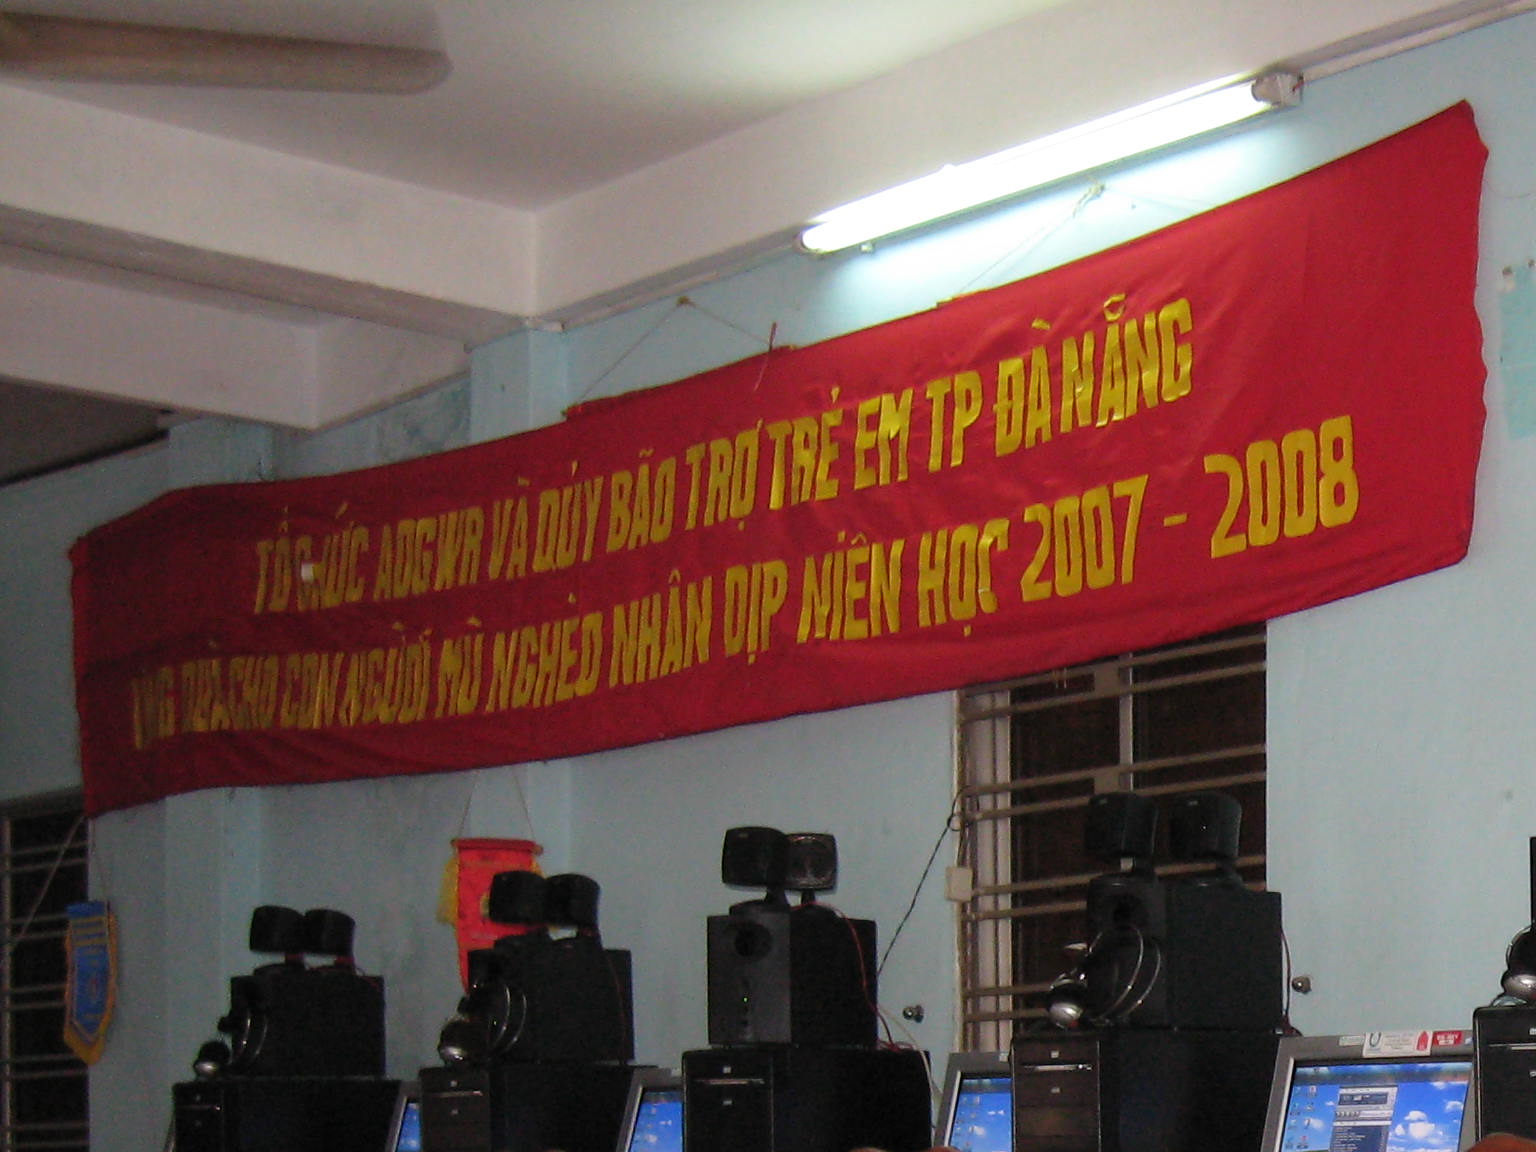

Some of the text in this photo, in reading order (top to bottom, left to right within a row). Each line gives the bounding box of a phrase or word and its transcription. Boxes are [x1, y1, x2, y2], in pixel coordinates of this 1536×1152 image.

[488, 475, 530, 581] VÀ
[684, 418, 765, 532] TRỢ
[853, 388, 914, 490] EM
[926, 369, 983, 474] TP
[992, 318, 1053, 458] ĐÀ
[609, 568, 713, 689] NHÂN
[724, 559, 789, 666] DỊP
[917, 517, 1010, 638] HỌC
[1020, 473, 1150, 603] 2007
[1203, 414, 1361, 560] 2008
